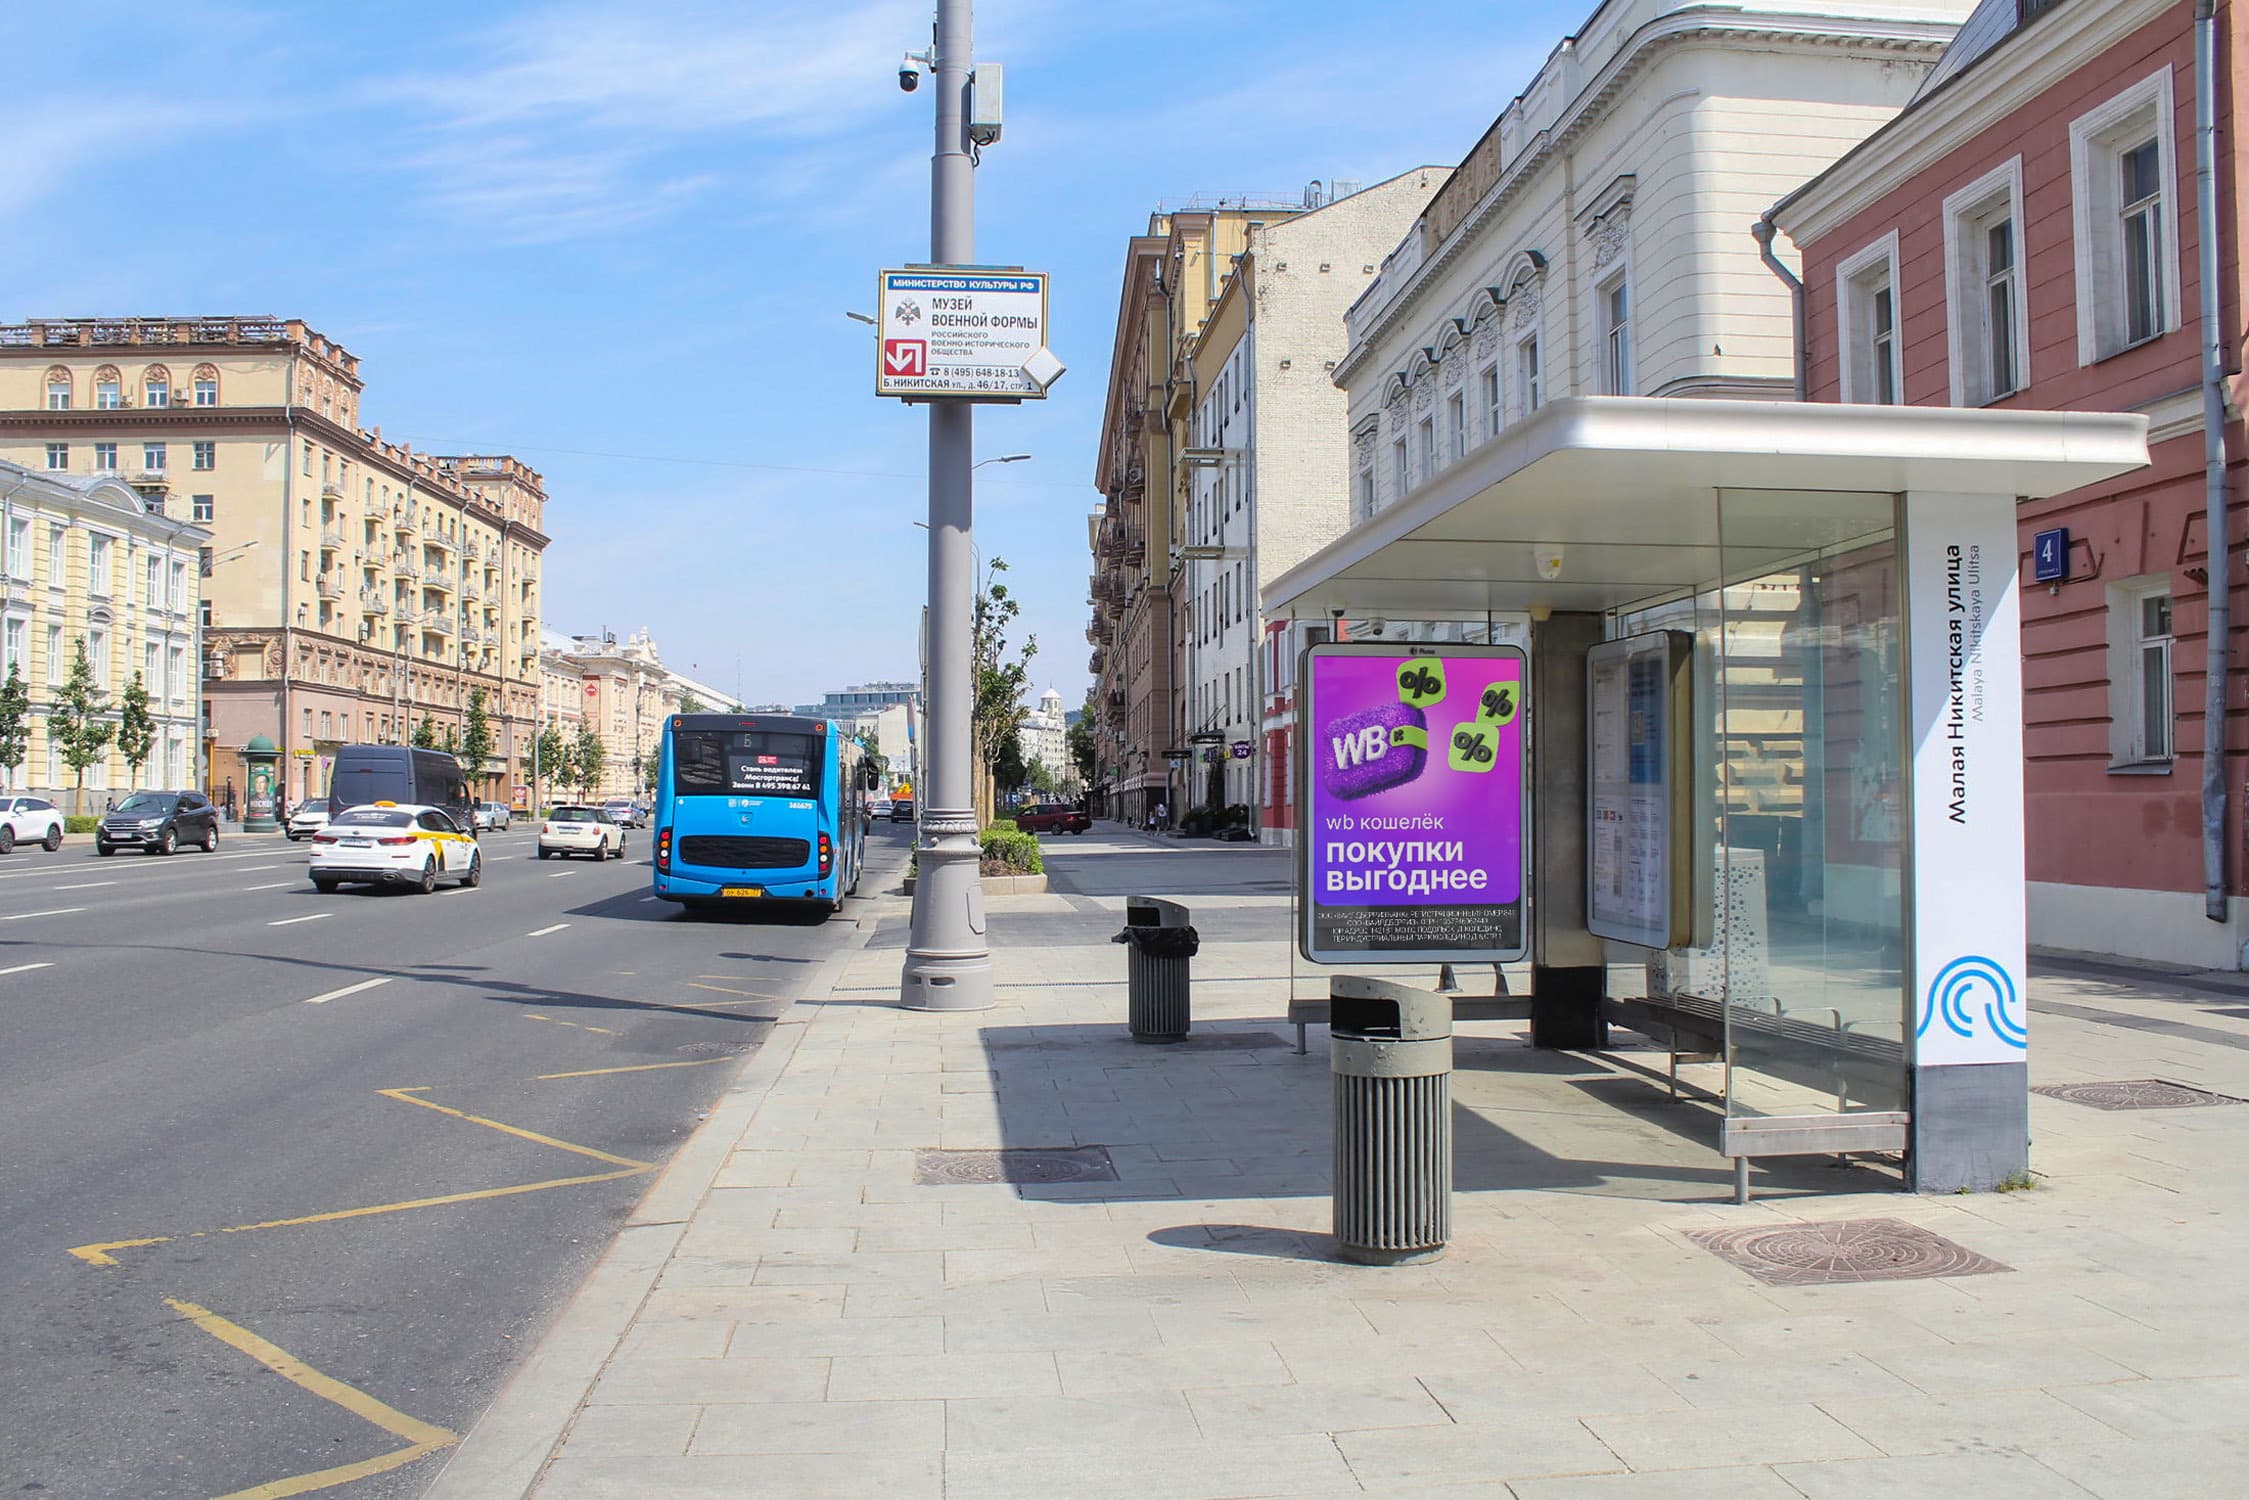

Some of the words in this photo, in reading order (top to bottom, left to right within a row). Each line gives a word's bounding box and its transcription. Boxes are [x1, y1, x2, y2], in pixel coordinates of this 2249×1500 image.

[893, 279, 966, 289] МИНИСТЕРСТВО
[969, 280, 1017, 290] КУЛЬТУРЫ
[1020, 281, 1035, 290] РФ
[932, 296, 972, 311] МУЗЕЙ
[931, 312, 988, 327] ВОЕННОЙ
[990, 315, 1038, 329] ФОРМЫ
[931, 330, 989, 339] РОССИЙСКОГО
[930, 348, 973, 356] ОБЩЕСТВА
[893, 378, 950, 388] НИКИТСКАЯ
[1027, 382, 1033, 390] 1
[943, 367, 950, 377] 8
[951, 367, 974, 378] (495)
[2042, 539, 2052, 562] 4
[1968, 545, 1980, 585] Ulitsa
[1947, 545, 1965, 613] улица
[1969, 589, 1983, 664] Nikitskaya
[1947, 619, 1964, 739] Никитская
[1971, 669, 1984, 722] Malaya
[1332, 725, 1388, 770] WB
[1948, 746, 1966, 824] Малая
[1326, 814, 1355, 831] wb
[1360, 812, 1444, 830] кошелёк
[1326, 841, 1464, 869] покупки
[1326, 868, 1488, 896] выгоднее
